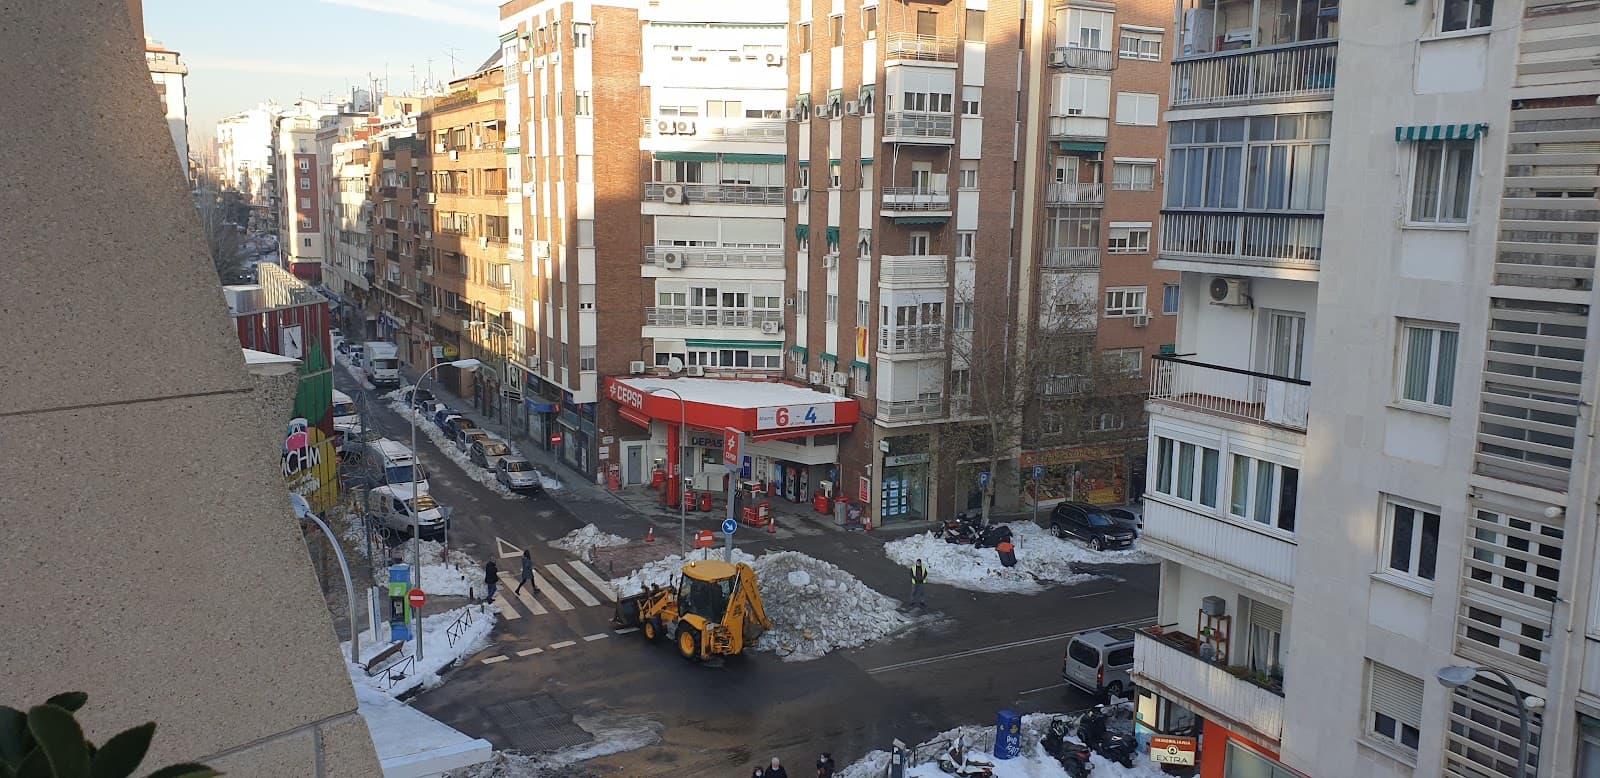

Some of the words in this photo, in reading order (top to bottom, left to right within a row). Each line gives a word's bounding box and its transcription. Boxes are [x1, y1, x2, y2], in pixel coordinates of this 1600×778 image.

[617, 385, 643, 410] CEPSA
[775, 407, 789, 427] 6
[804, 406, 817, 424] 4
[1034, 466, 1042, 477] P
[980, 473, 988, 484] P
[1156, 754, 1188, 764] EXTRA
